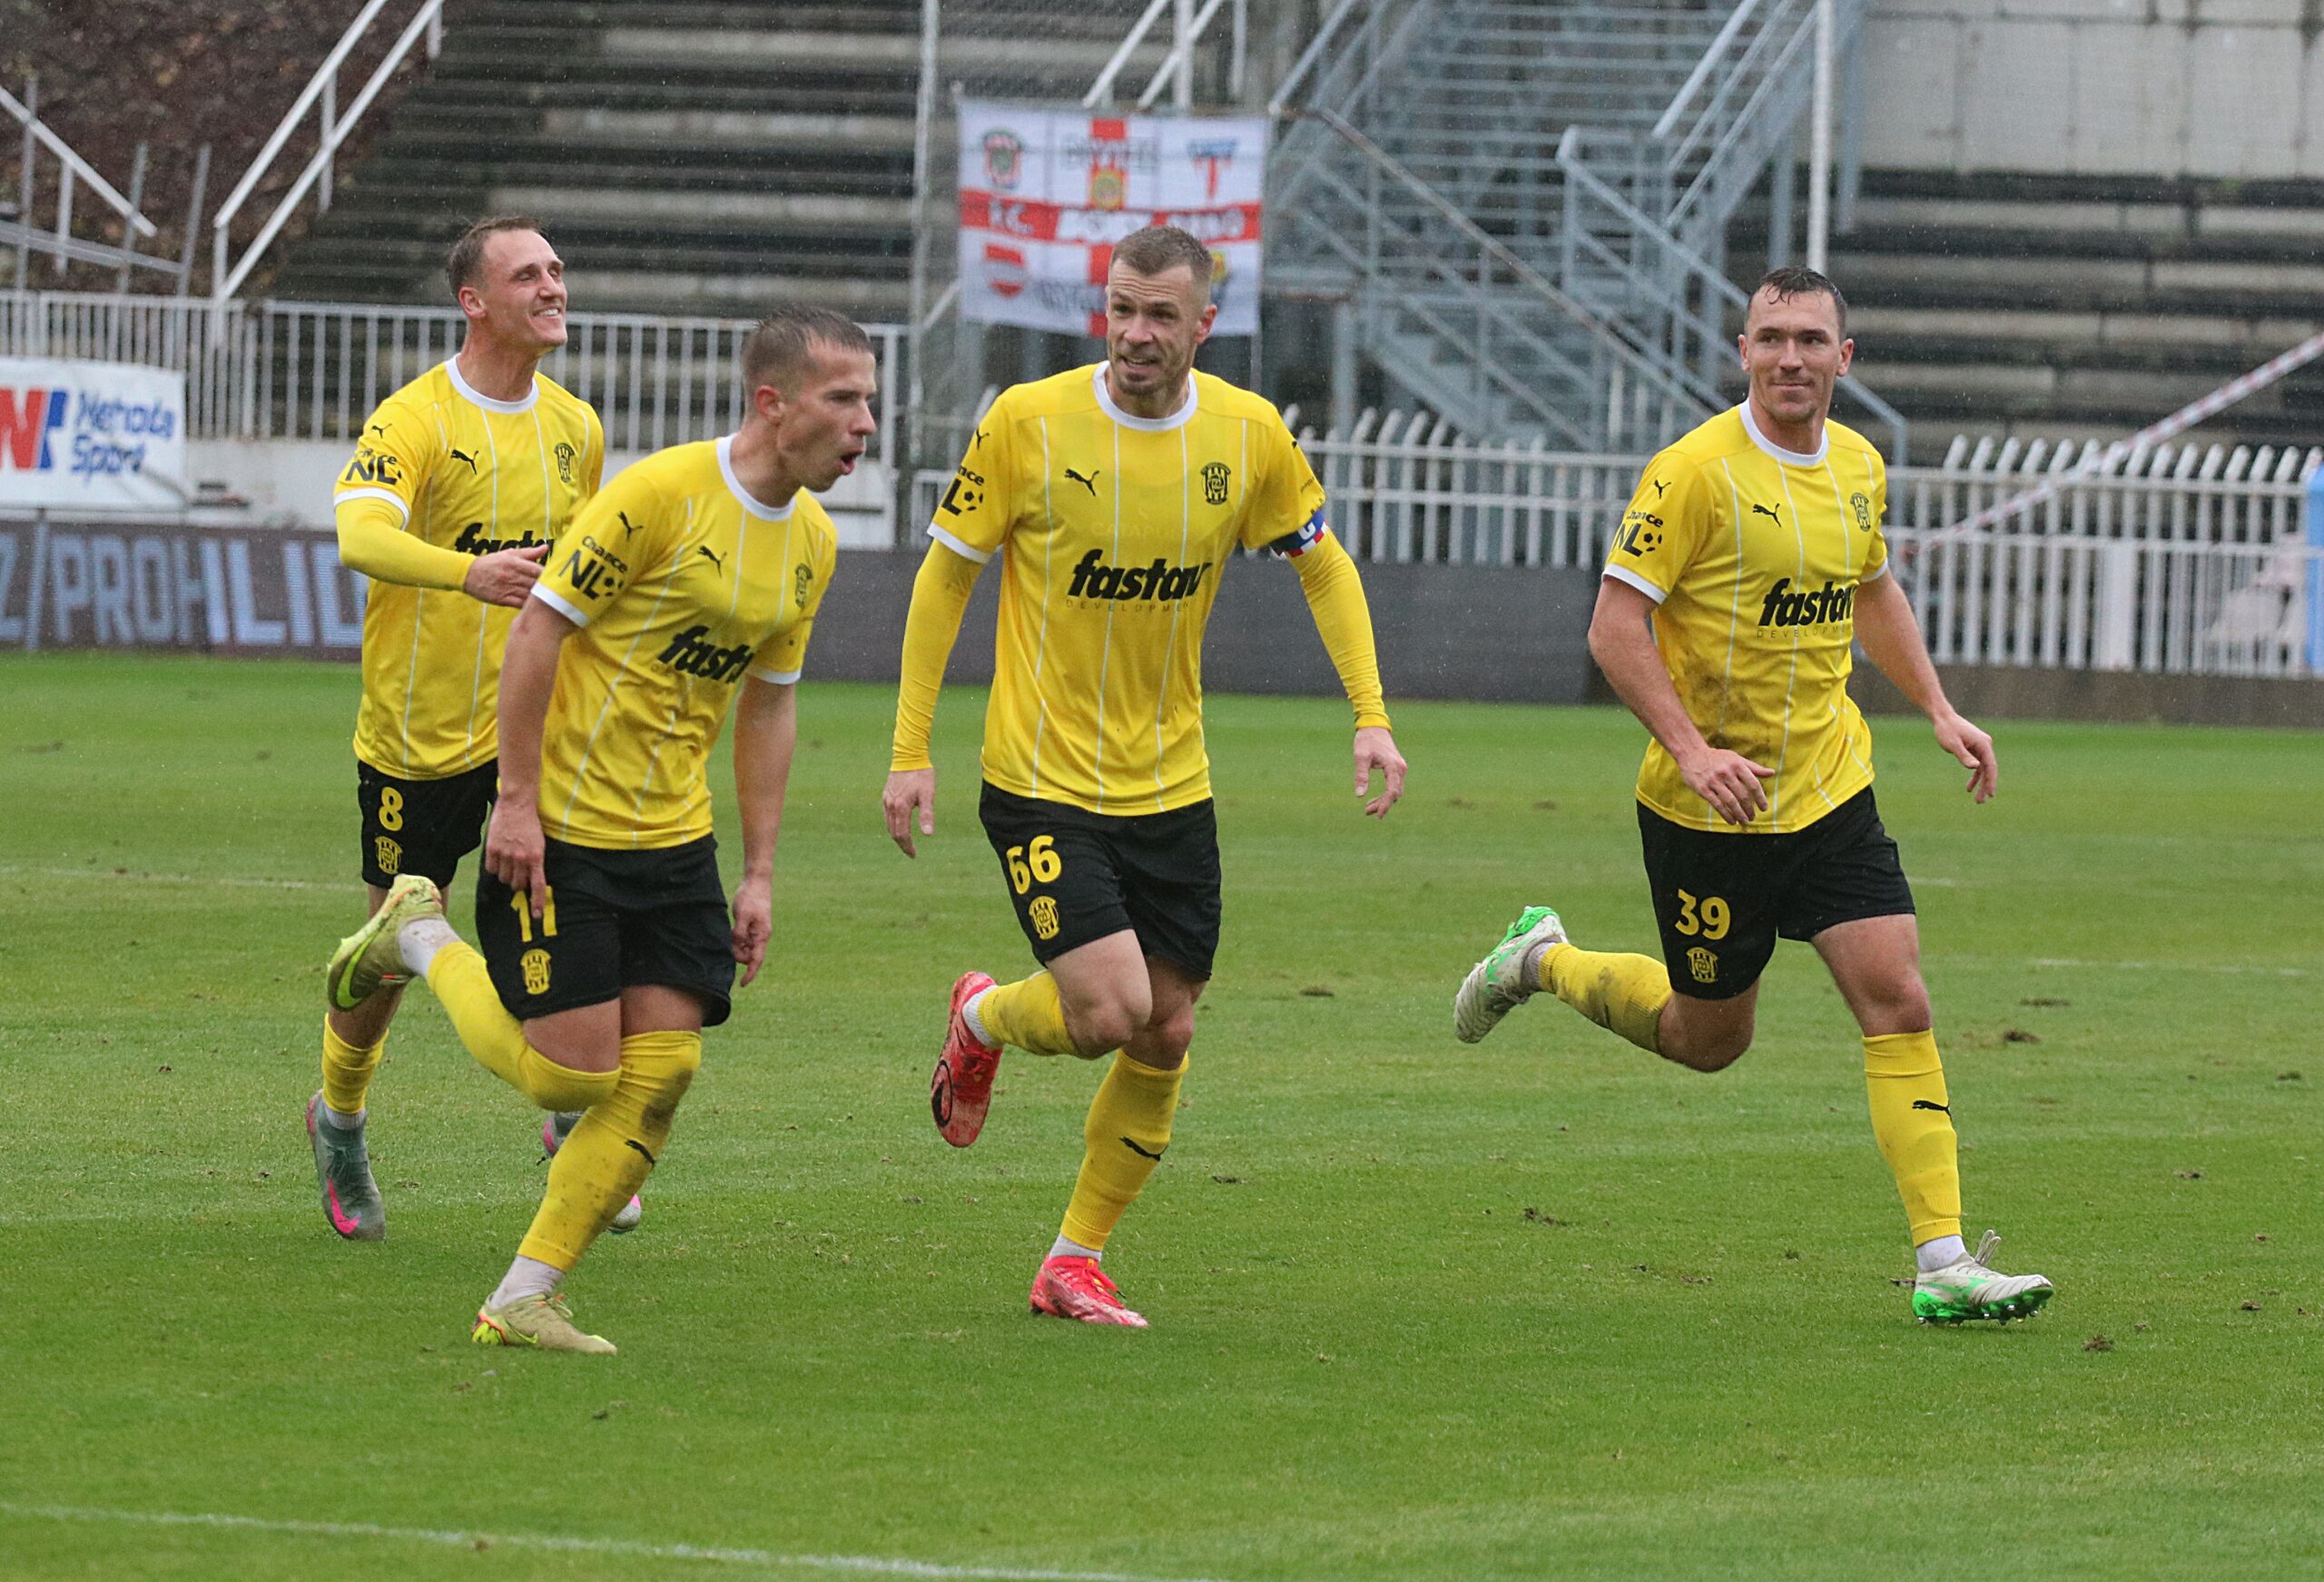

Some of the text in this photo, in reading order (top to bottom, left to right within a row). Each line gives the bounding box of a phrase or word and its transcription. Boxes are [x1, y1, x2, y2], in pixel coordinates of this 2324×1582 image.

[941, 477, 962, 516] L
[959, 465, 985, 486] nce
[558, 548, 606, 601] NL
[1067, 548, 1214, 602] fastav
[656, 624, 755, 683] fast
[378, 786, 404, 831] 8
[1006, 834, 1062, 895] 66
[510, 885, 558, 943] 11
[1674, 888, 1731, 941] 39
